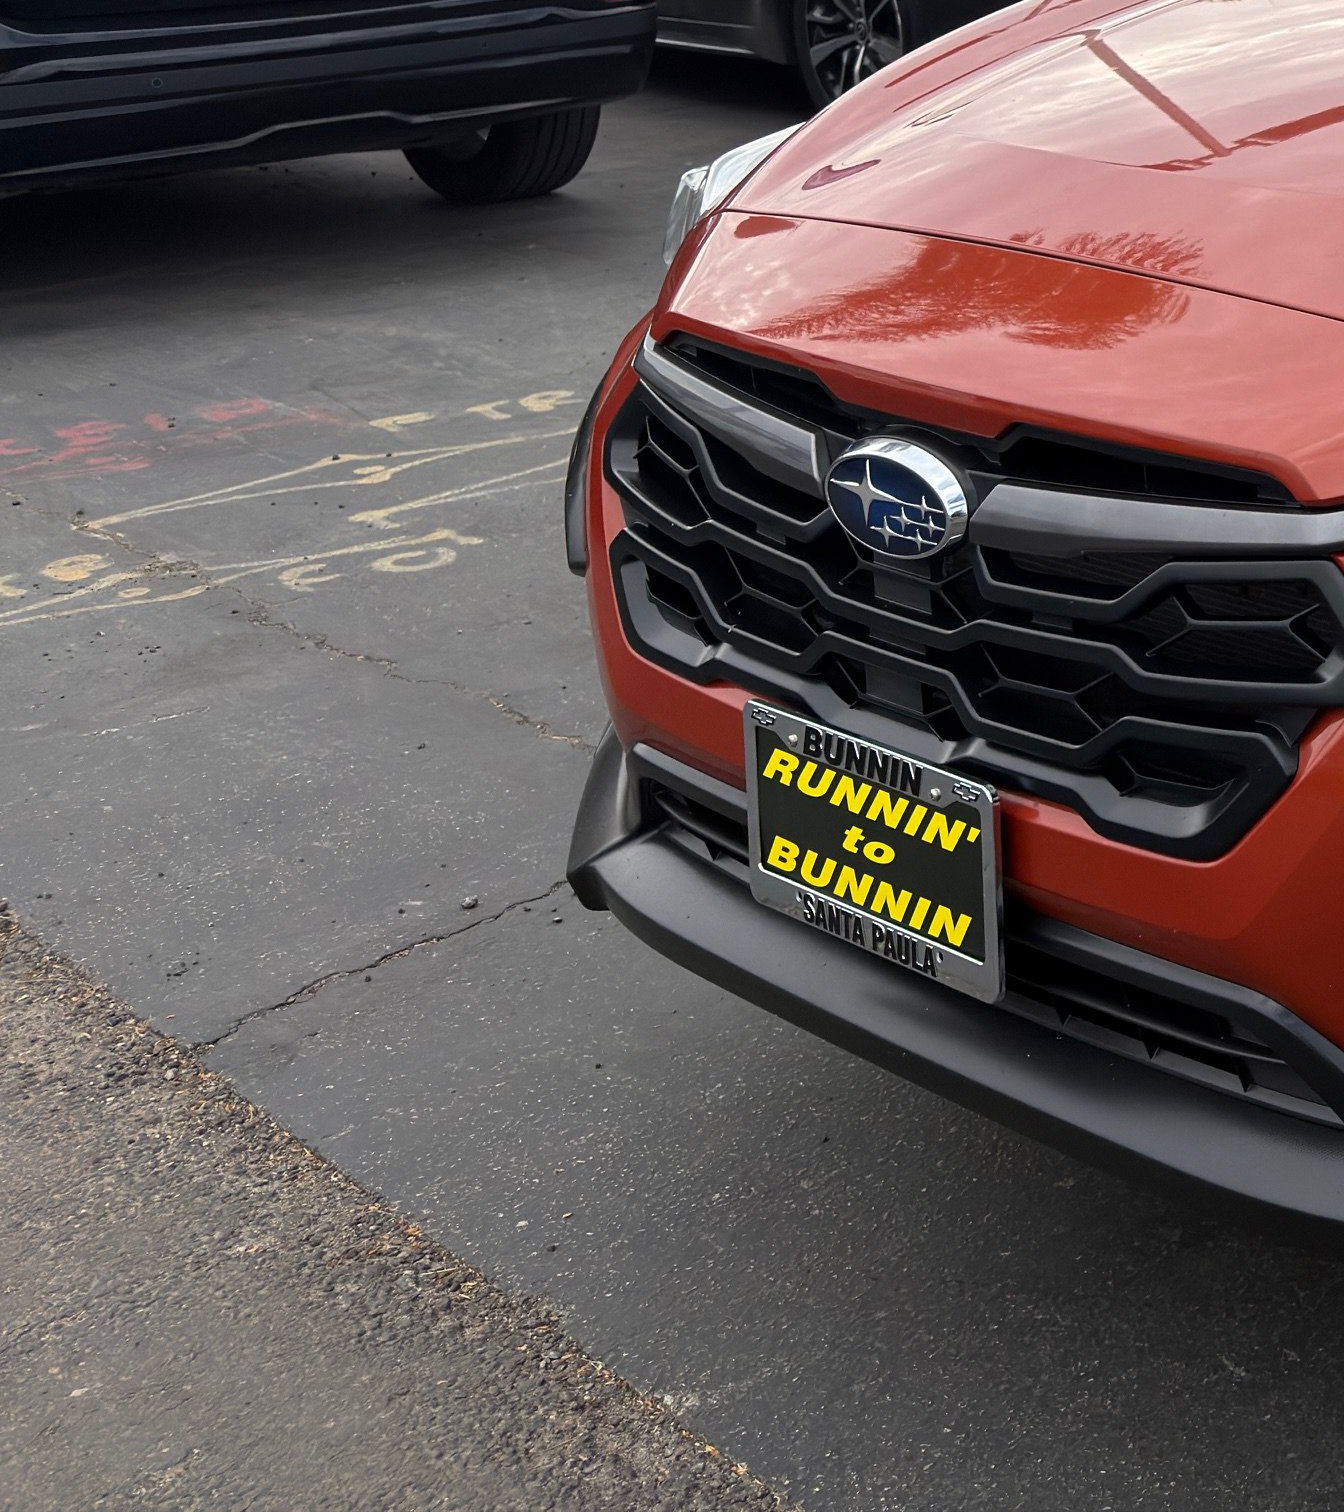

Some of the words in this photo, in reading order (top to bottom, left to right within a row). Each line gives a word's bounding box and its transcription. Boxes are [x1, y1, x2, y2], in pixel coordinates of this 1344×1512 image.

[762, 748, 981, 852] RUNNIN'
[803, 725, 922, 796] BUNNIN
[842, 826, 896, 864] to
[767, 835, 972, 947] BUNNIN
